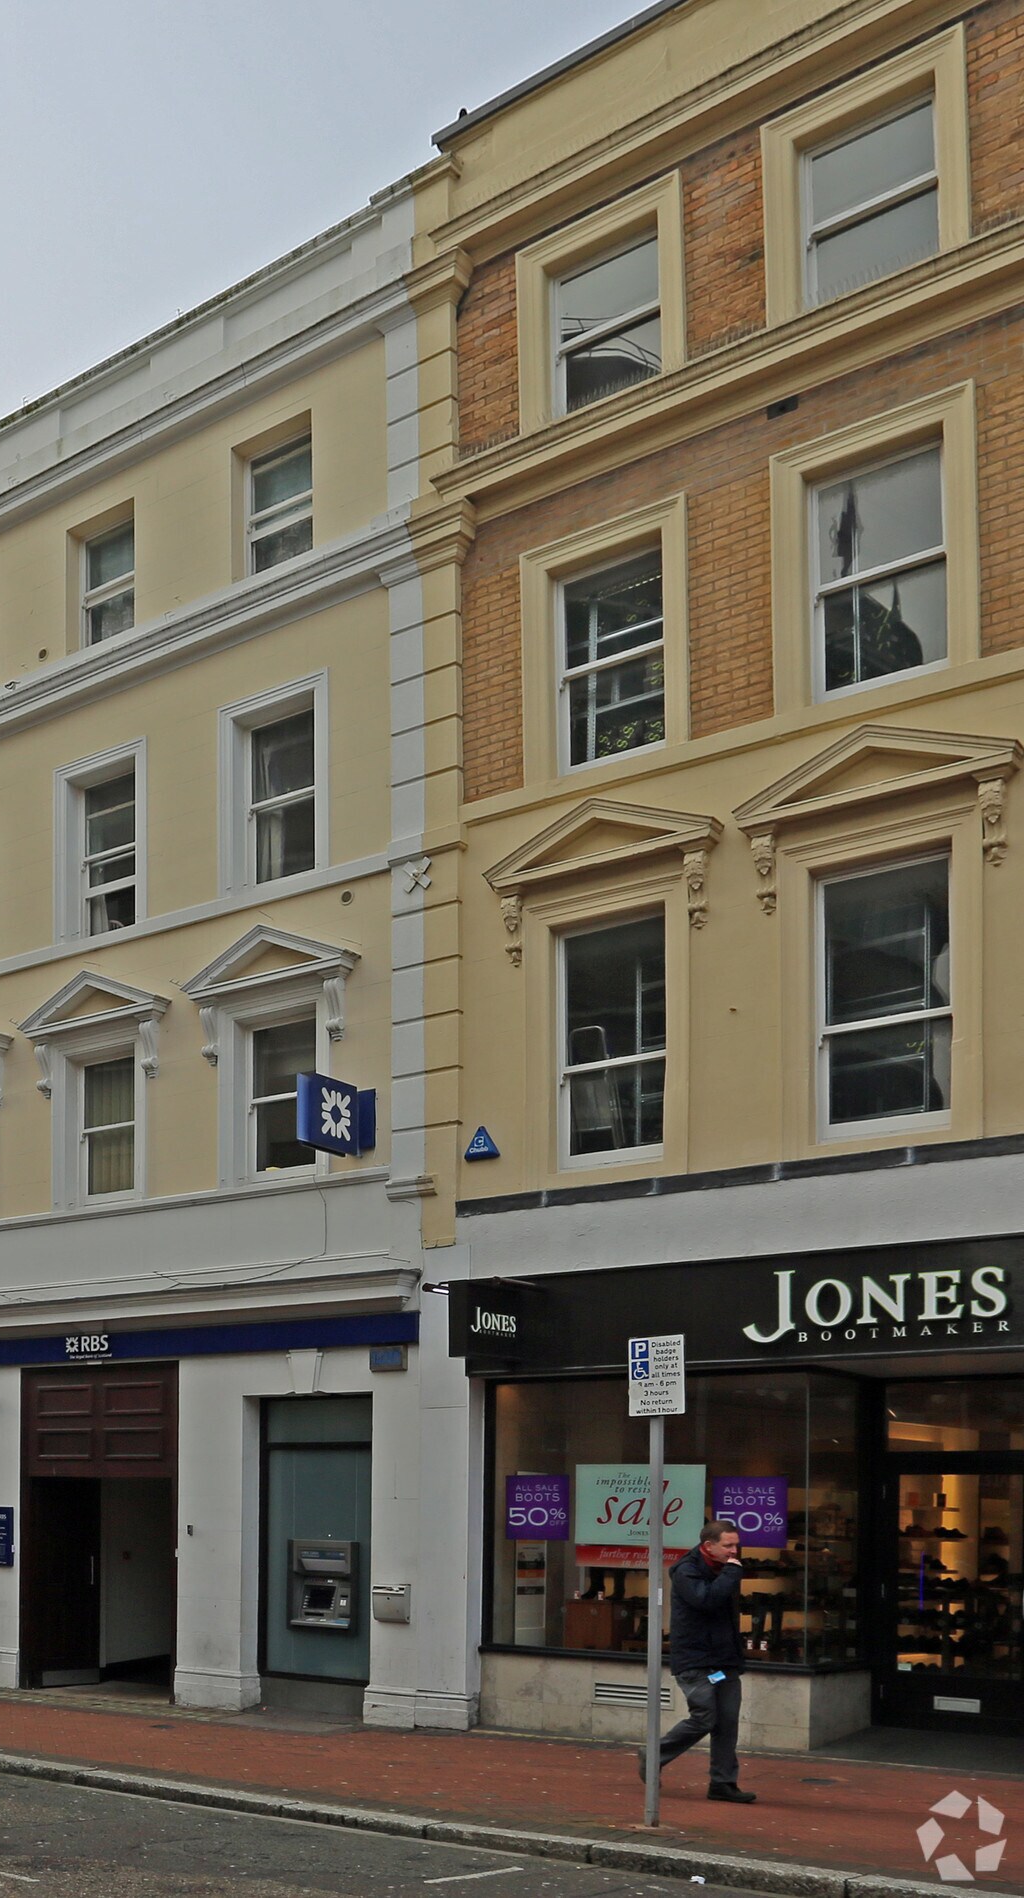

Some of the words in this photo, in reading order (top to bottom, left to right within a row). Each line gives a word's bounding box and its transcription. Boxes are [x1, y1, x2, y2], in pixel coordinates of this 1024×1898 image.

[742, 1266, 1007, 1343] JONES
[470, 1306, 516, 1333] JONES
[798, 1321, 1010, 1343] BOOTMAKER
[80, 1334, 109, 1352] RBS
[651, 1340, 681, 1348] Disabled
[635, 1342, 646, 1358] P
[665, 1380, 677, 1388] pm
[515, 1484, 532, 1492] ALL
[535, 1484, 559, 1492] SALE
[627, 1486, 651, 1494] resis
[723, 1486, 743, 1494] ALL
[747, 1486, 776, 1495] SALE
[515, 1492, 561, 1502] BOOTS
[723, 1495, 777, 1506] BOOTS
[508, 1507, 567, 1526] 50%
[763, 1525, 784, 1533] OFF
[597, 1547, 632, 1560] further
